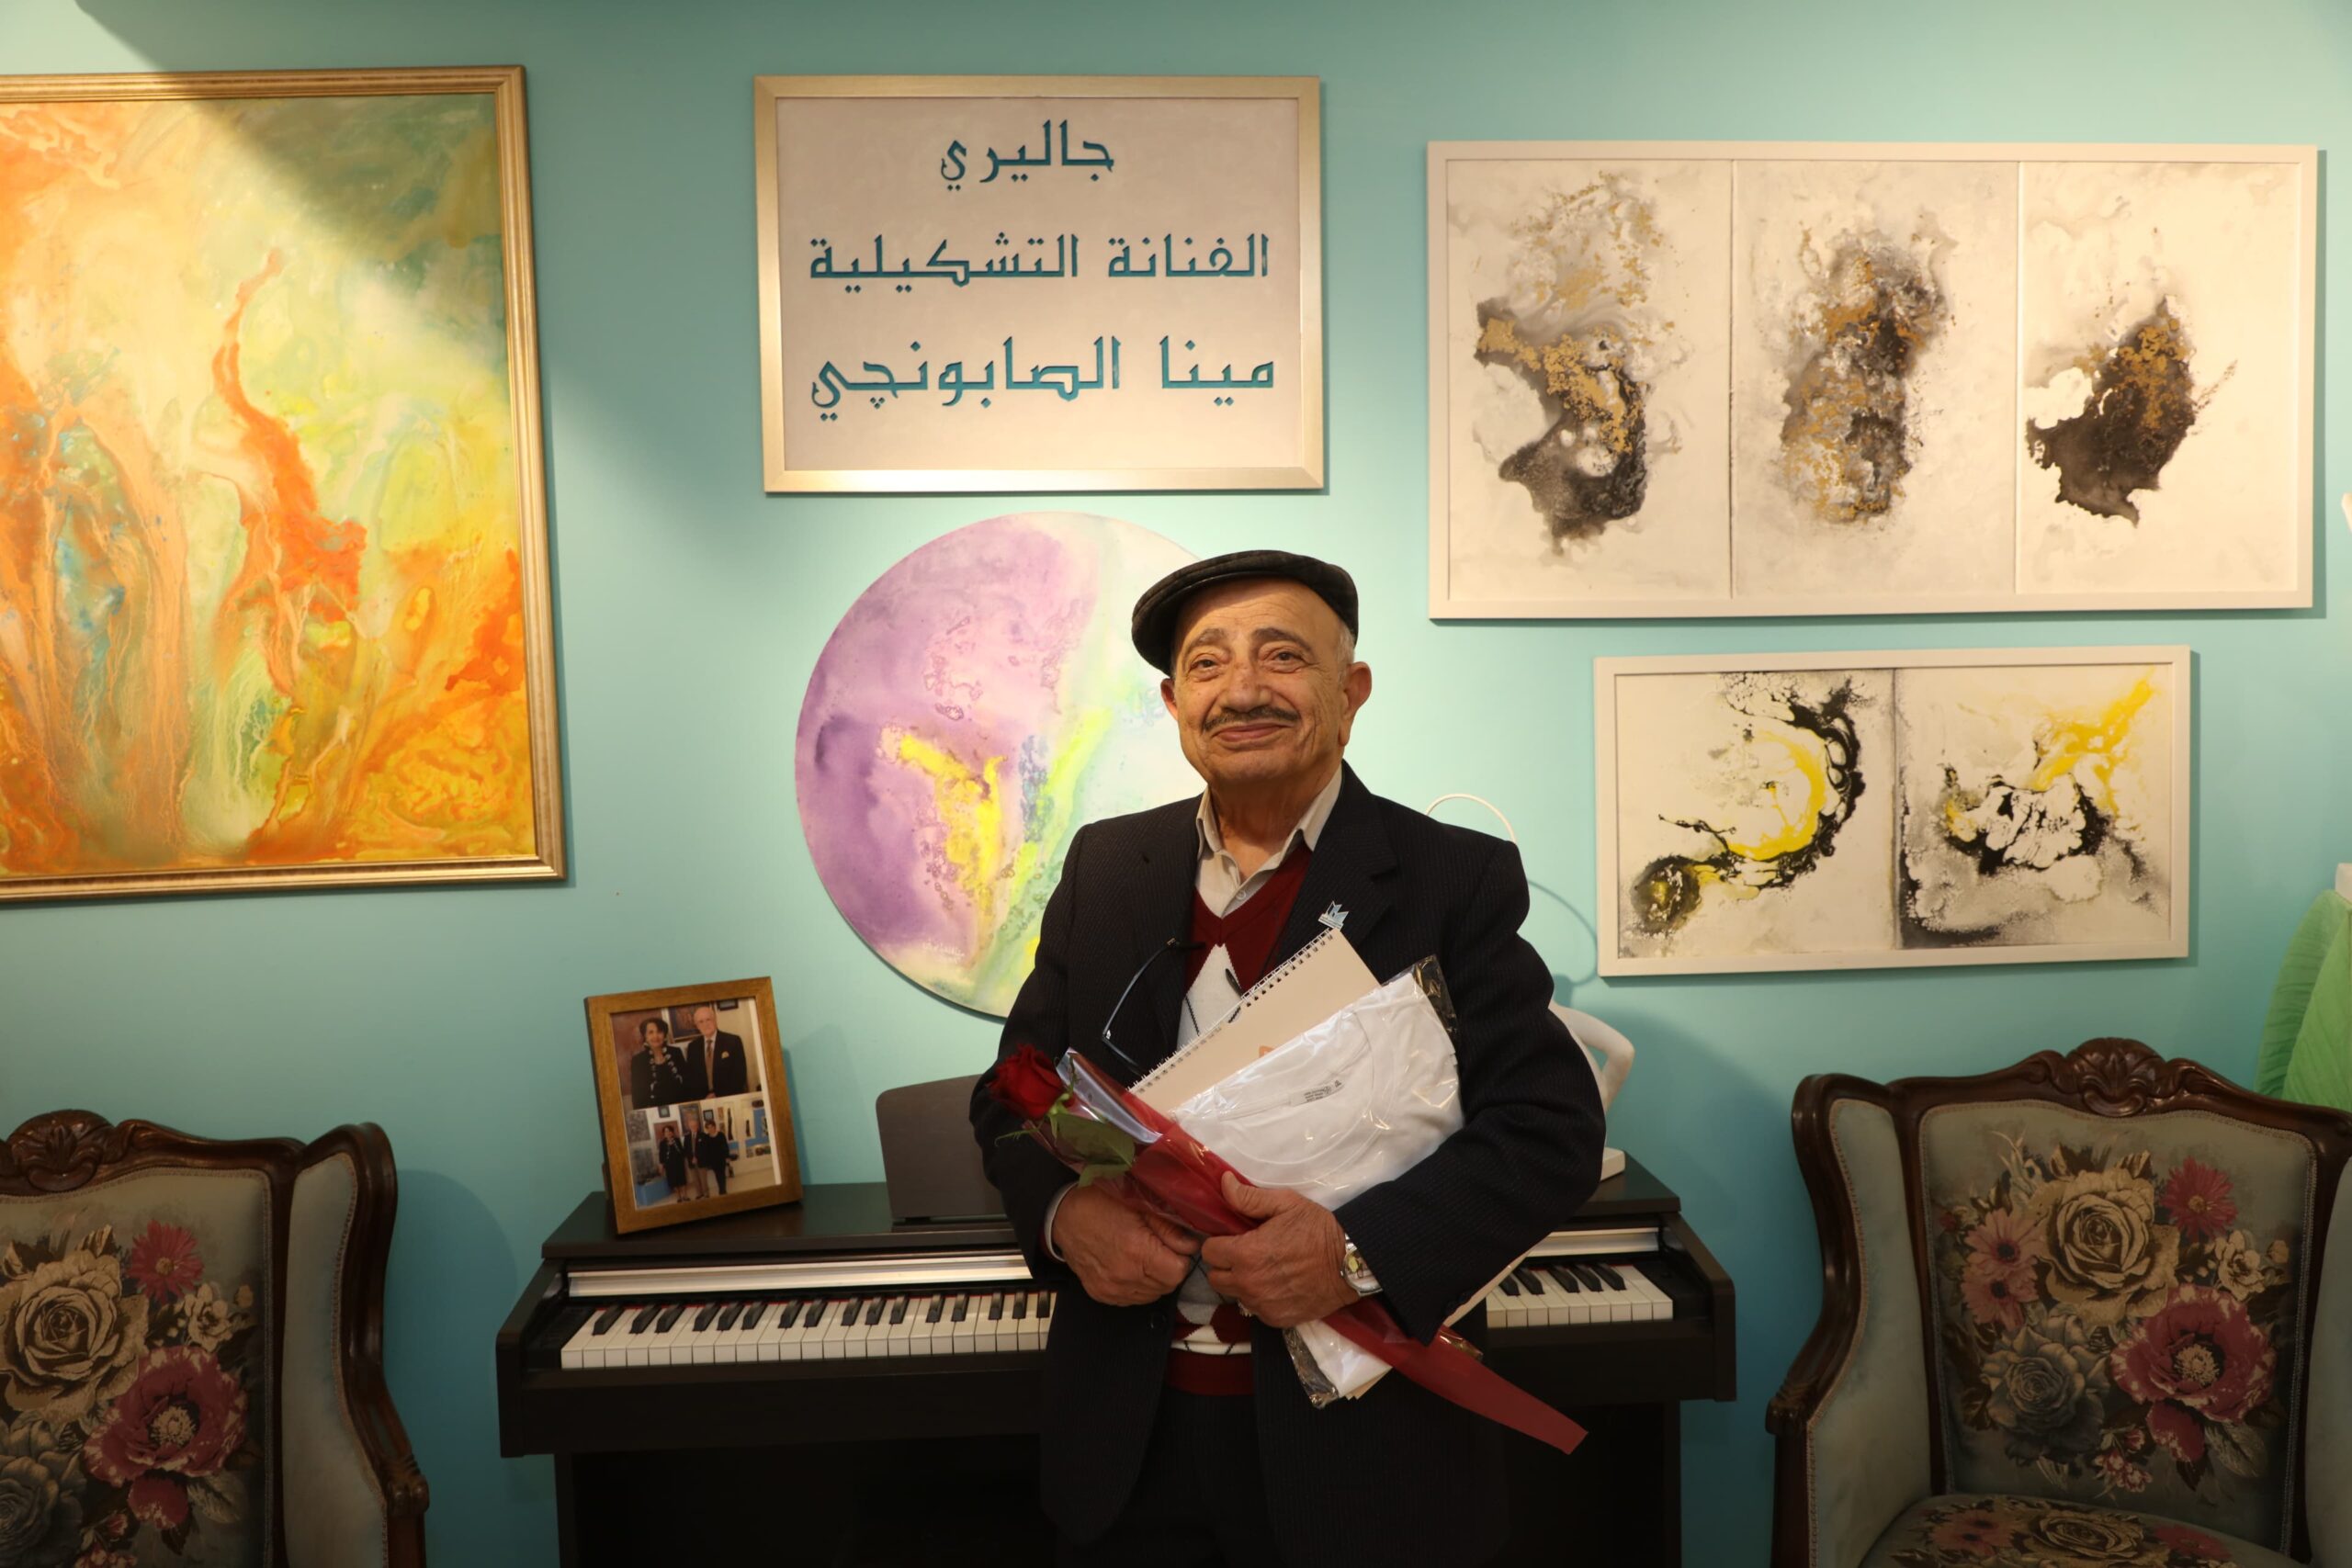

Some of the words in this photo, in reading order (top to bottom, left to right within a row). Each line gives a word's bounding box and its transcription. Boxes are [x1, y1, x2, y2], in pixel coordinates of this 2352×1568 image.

[940, 119, 1114, 192] جاليري
[809, 232, 1080, 294] التشكيلية
[1108, 233, 1270, 279] الفنانة
[1159, 335, 1274, 407] مينا
